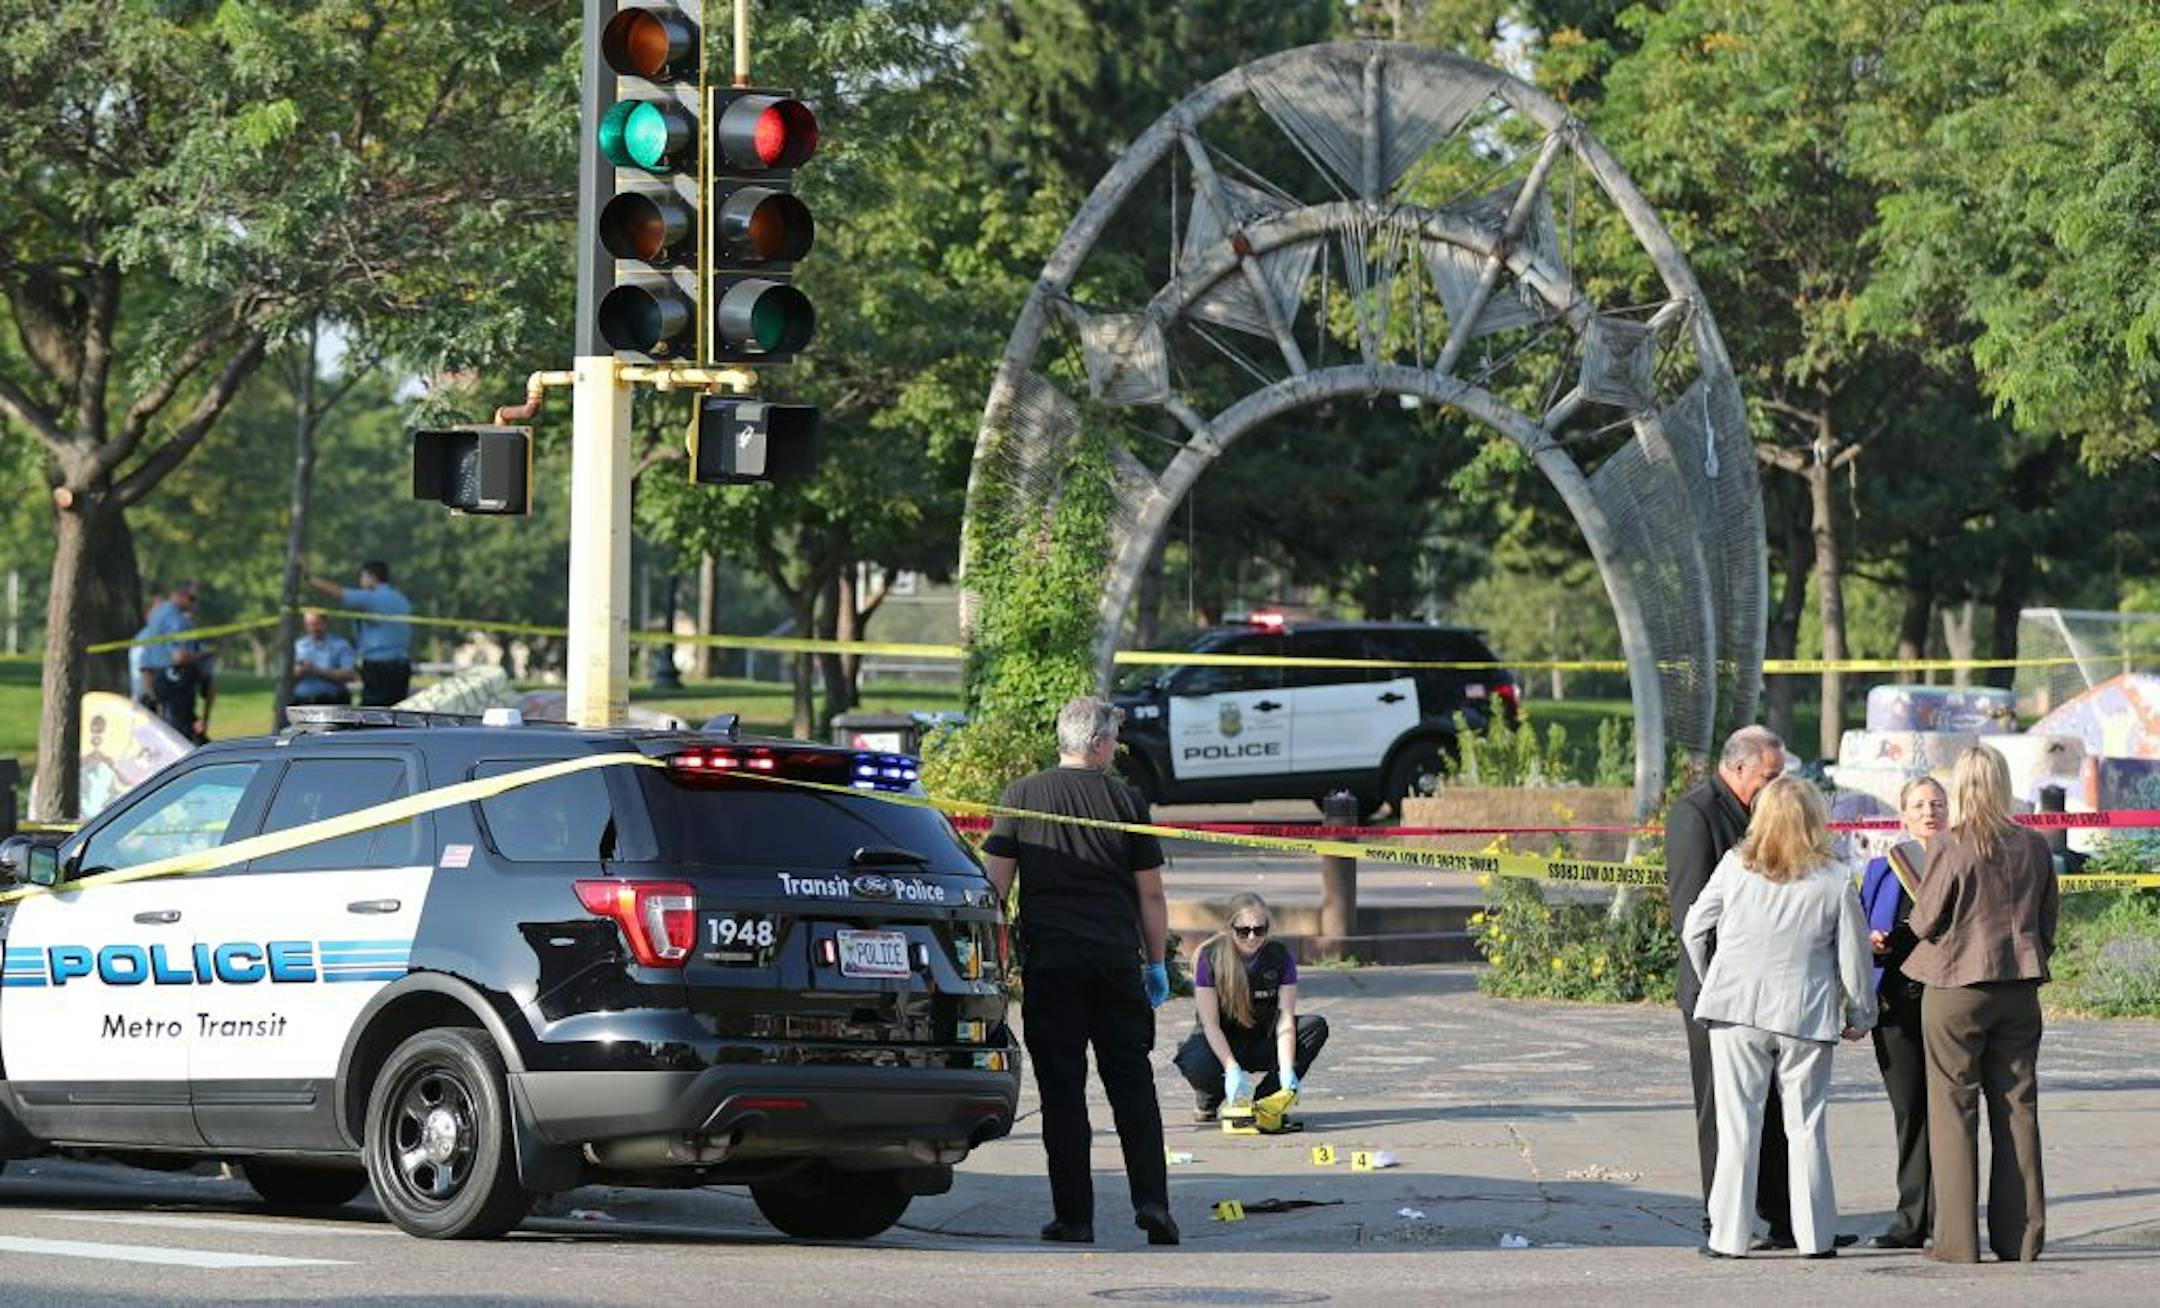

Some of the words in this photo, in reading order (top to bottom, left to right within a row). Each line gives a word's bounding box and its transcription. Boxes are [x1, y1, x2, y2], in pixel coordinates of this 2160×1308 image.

[1183, 743, 1281, 760] POLICE
[2080, 812, 2111, 825] CROSS
[1435, 854, 1466, 869] SCENE
[1470, 857, 1499, 873] CRIME
[1548, 863, 1578, 880] CROSS
[1581, 864, 1599, 880] NOT
[1601, 867, 1614, 882] DO
[777, 872, 850, 896] Transit
[893, 878, 945, 901] Police
[707, 919, 774, 947] 1948
[856, 942, 903, 965] POLICE
[48, 941, 317, 986] POLICE
[101, 1014, 182, 1039] Metro
[196, 1012, 288, 1038] Transit
[1319, 1147, 1329, 1162] 3
[1358, 1153, 1367, 1168] 4
